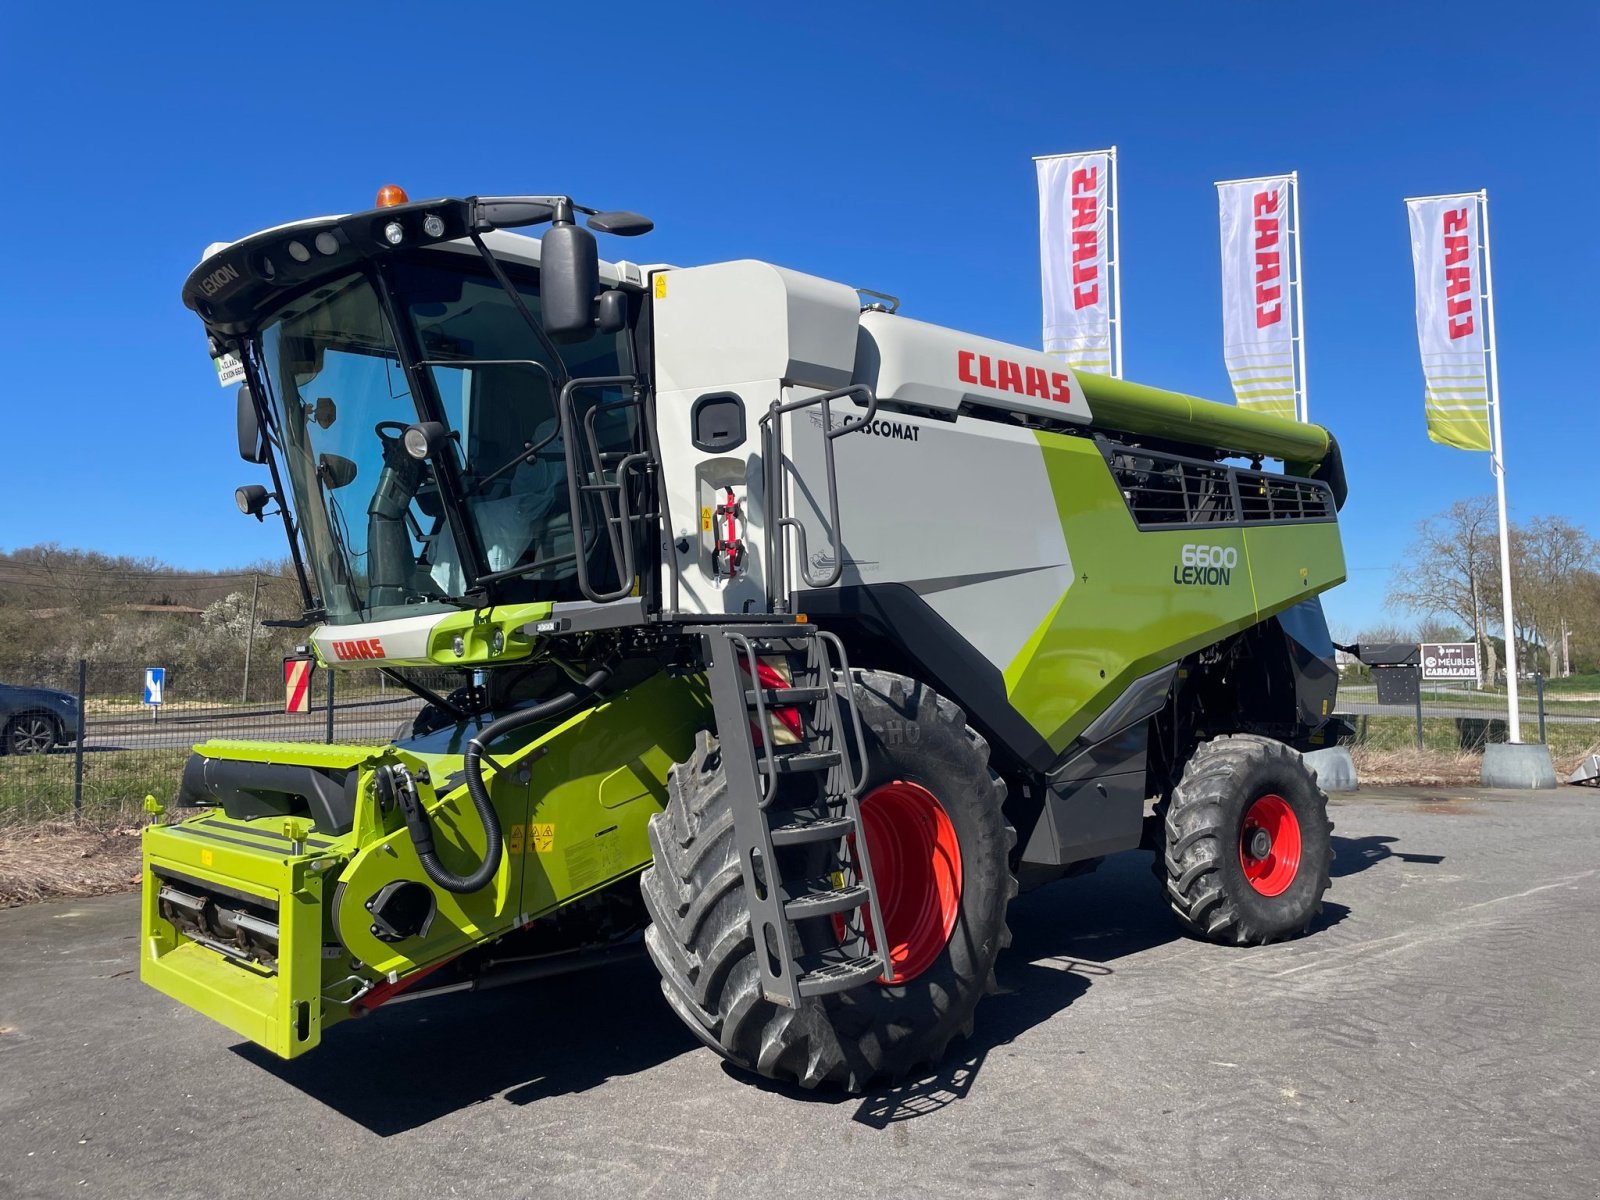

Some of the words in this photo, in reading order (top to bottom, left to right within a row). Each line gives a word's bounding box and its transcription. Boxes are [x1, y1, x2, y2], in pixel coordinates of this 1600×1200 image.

[198, 263, 240, 297] LEXION
[958, 350, 1071, 404] CLAAS
[1181, 544, 1238, 569] 6600
[1173, 565, 1231, 586] LEXION
[332, 638, 387, 661] CLAAS
[1425, 667, 1476, 676] CARSALADE
[1438, 658, 1475, 667] MEUBLES
